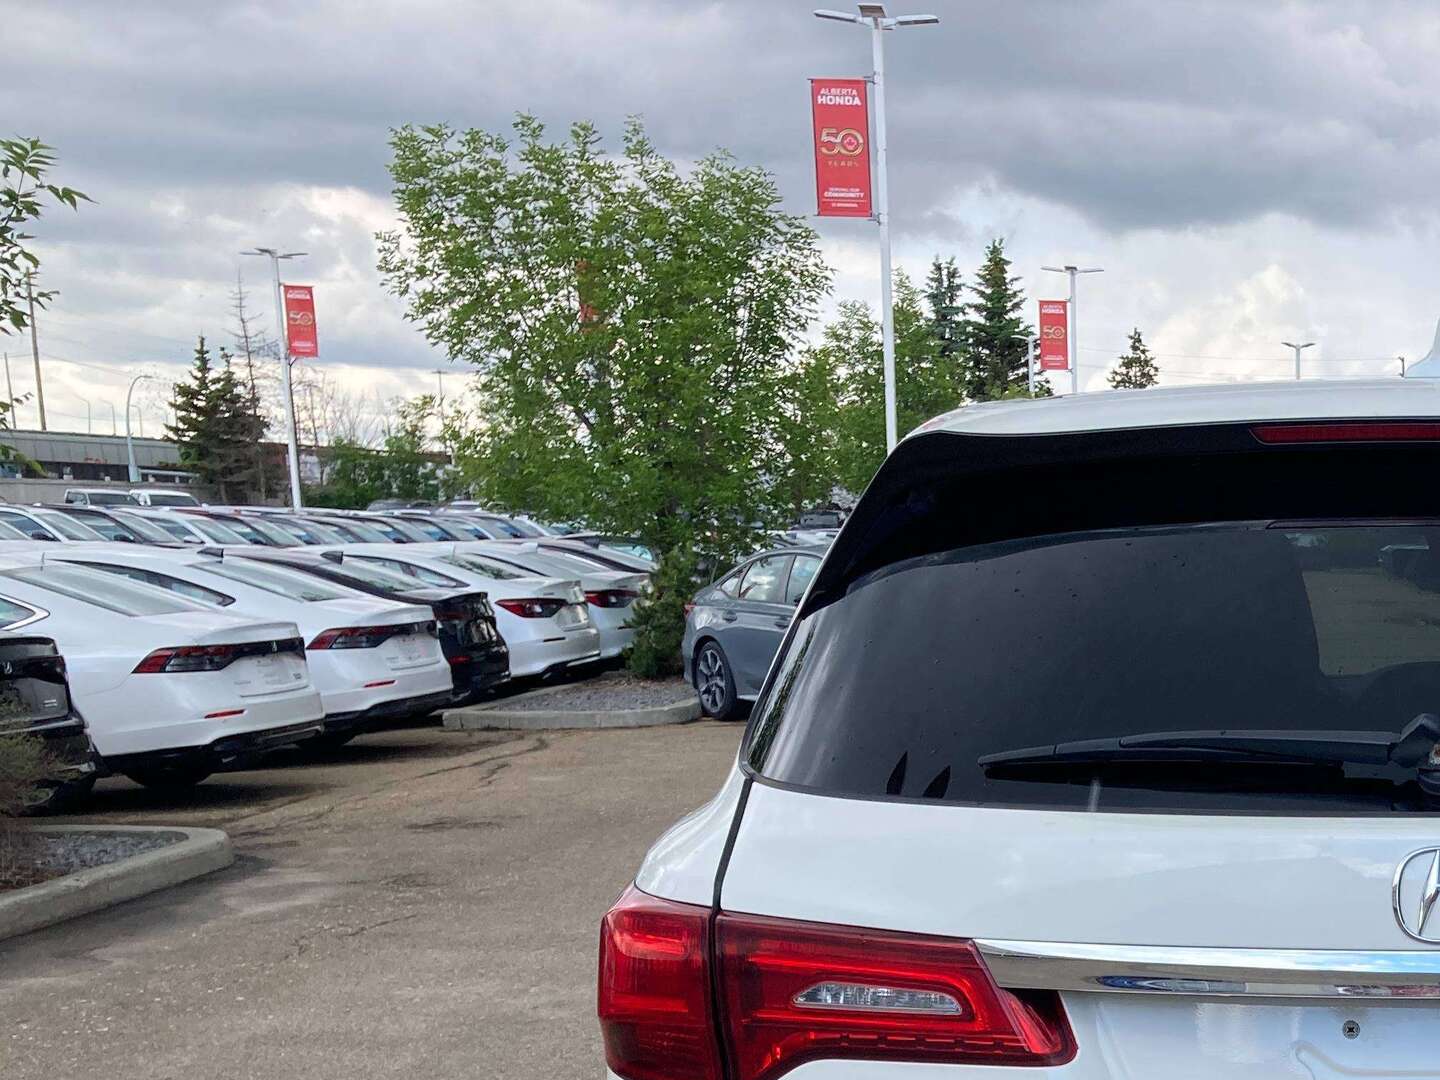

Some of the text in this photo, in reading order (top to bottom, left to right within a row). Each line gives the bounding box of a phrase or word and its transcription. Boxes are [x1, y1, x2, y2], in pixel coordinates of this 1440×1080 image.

[820, 87, 858, 96] ALBERTA
[817, 95, 862, 106] HONDA
[820, 127, 865, 157] 50
[1042, 324, 1065, 339] 50
